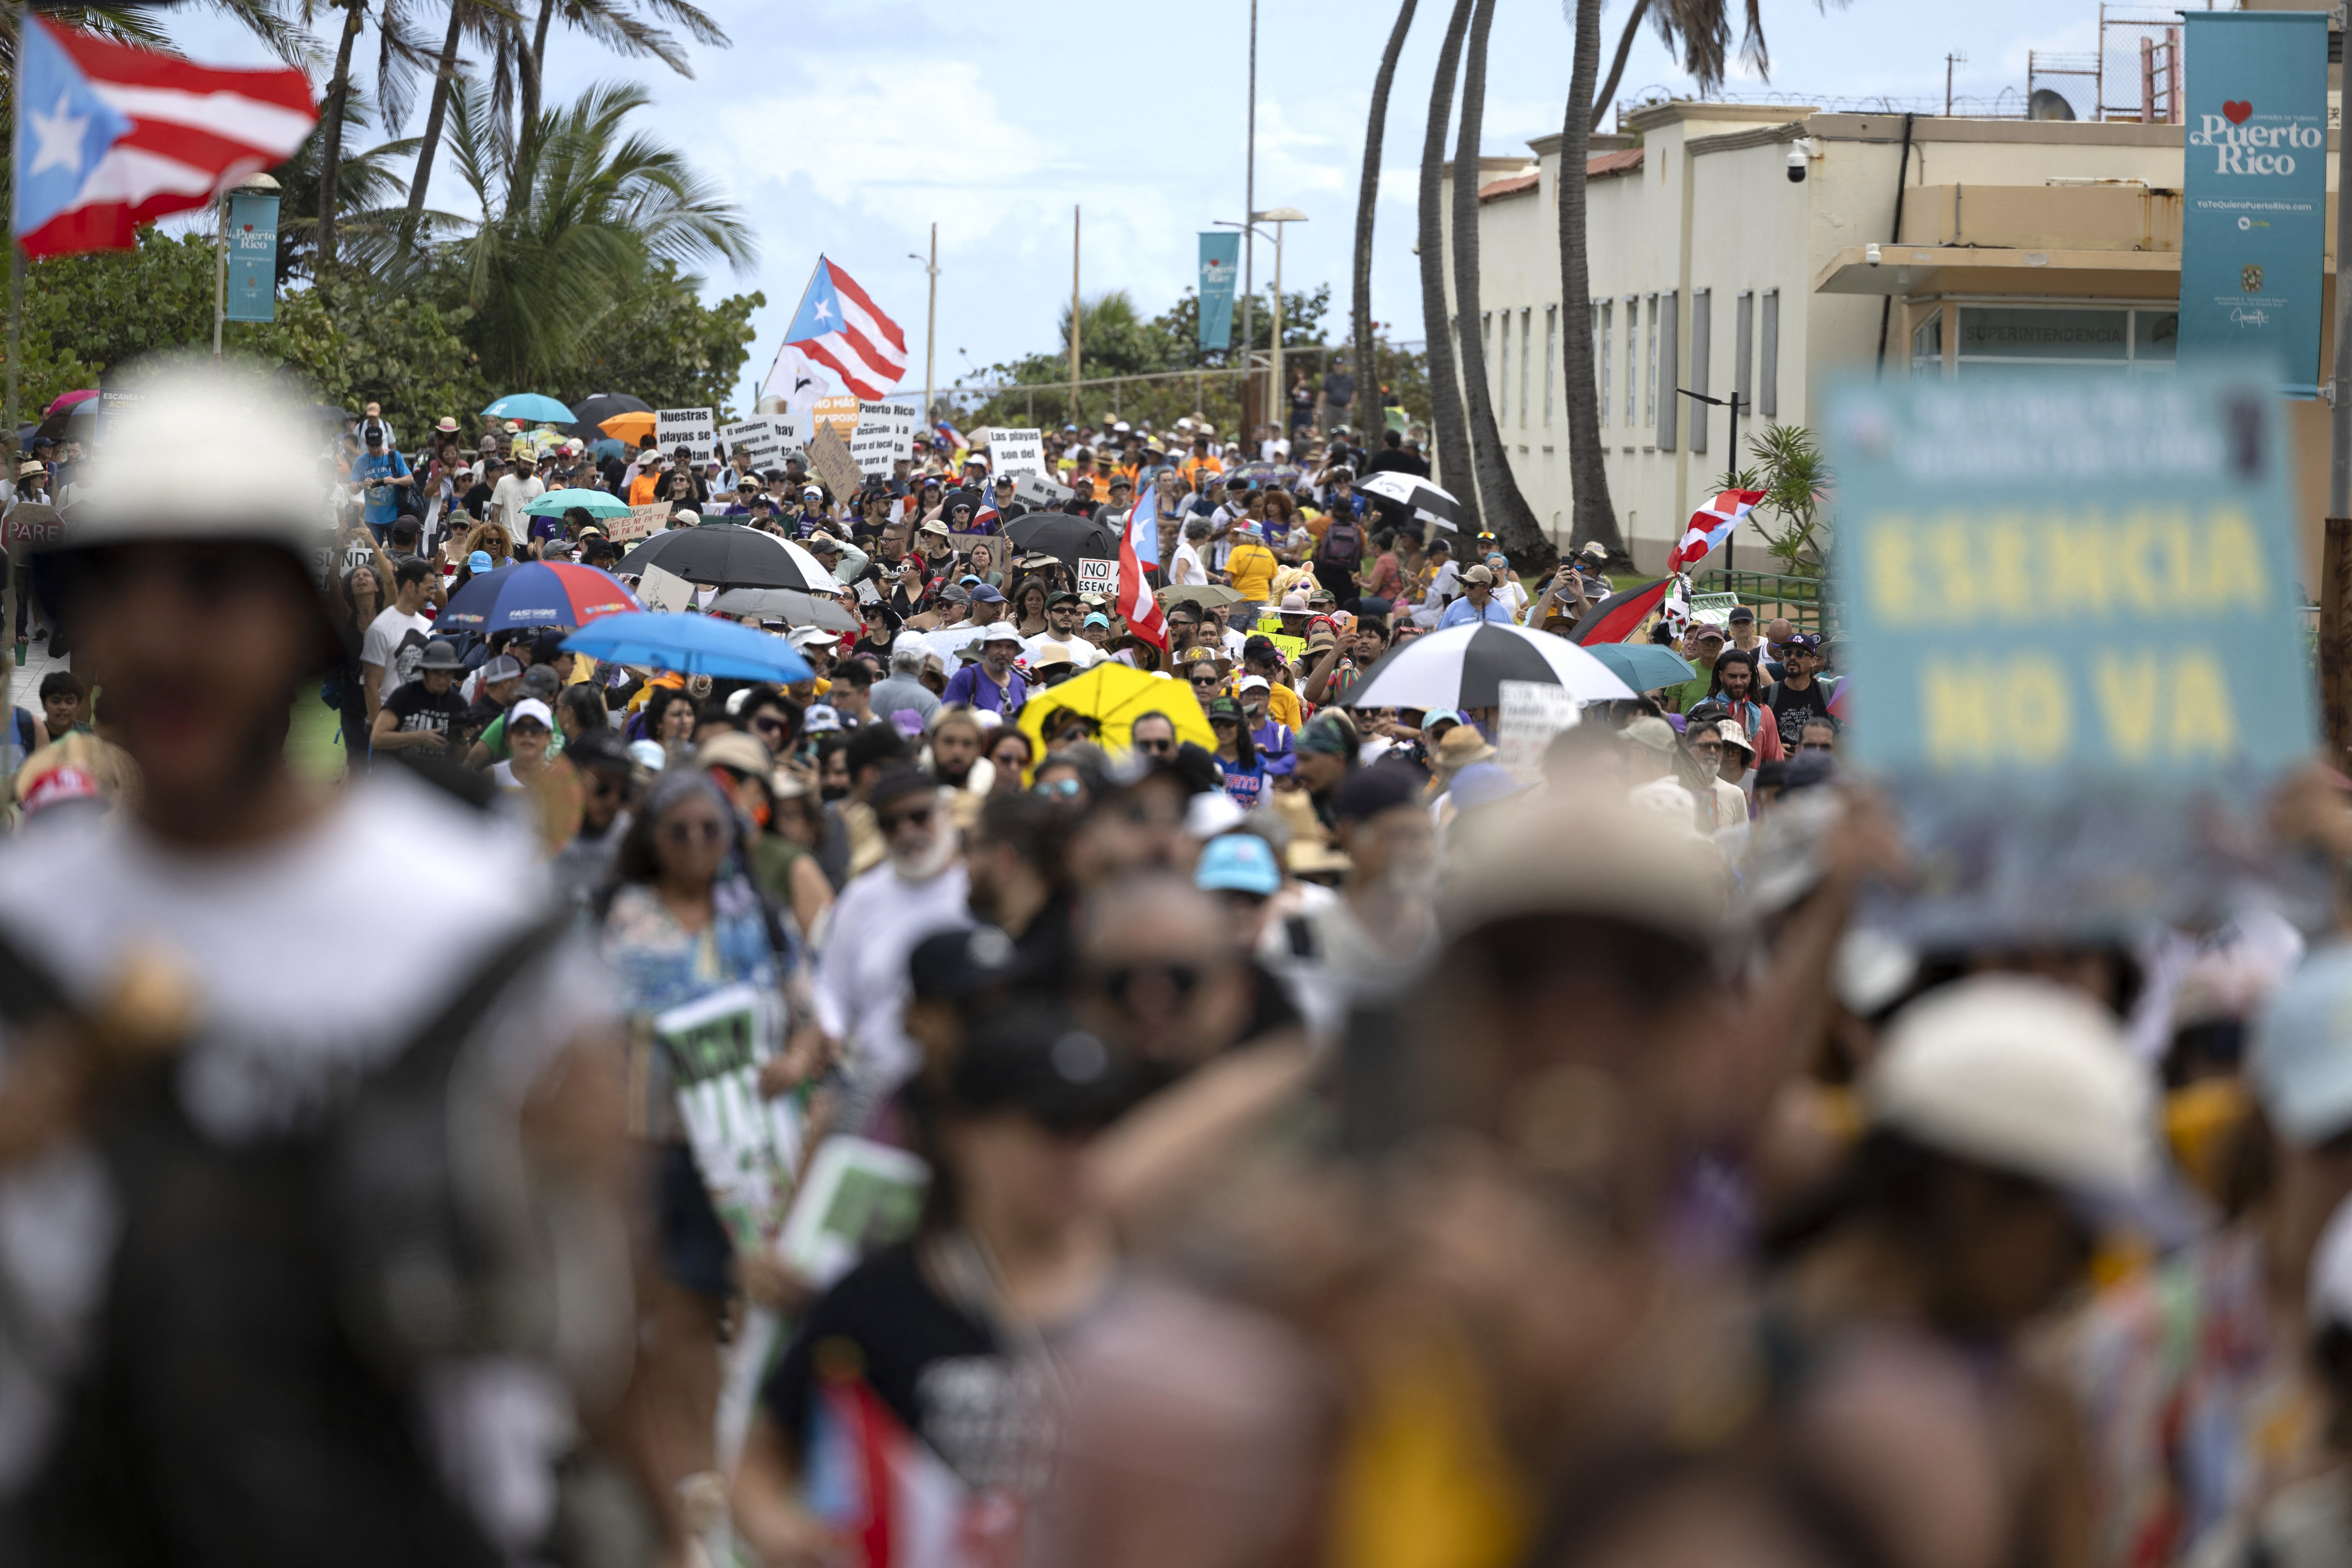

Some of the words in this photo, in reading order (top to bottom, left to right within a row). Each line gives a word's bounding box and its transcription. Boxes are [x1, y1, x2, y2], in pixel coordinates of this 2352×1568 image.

[2190, 114, 2321, 148] Puerto
[2214, 143, 2295, 175] Rico
[232, 229, 275, 241] Puerto
[240, 238, 267, 249] Rico
[1966, 325, 2121, 343] SUPERINTENDENCIA
[814, 399, 831, 409] NO
[833, 396, 856, 408] MÁS
[860, 403, 891, 415] Puerto
[894, 405, 915, 416] Rico
[661, 411, 708, 422] Nuestras
[734, 421, 768, 434] verdadero
[857, 425, 890, 436] Desarrollo
[660, 431, 694, 444] playas
[698, 431, 711, 441] se
[991, 432, 1006, 441] Las
[1009, 431, 1039, 442] playas
[852, 443, 867, 452] para
[869, 441, 875, 449] el
[877, 439, 893, 448] local
[882, 454, 888, 463] el
[1001, 451, 1018, 459] son
[1021, 448, 1035, 458] del
[1032, 482, 1044, 494] No
[1045, 488, 1057, 497] es
[621, 519, 631, 527] ES
[8, 521, 59, 542] PARE
[1084, 563, 1107, 577] NO
[810, 578, 833, 588] NAUTICA
[1079, 581, 1119, 593] ESENCI
[1921, 659, 2070, 769] NO
[2095, 649, 2238, 766] VA
